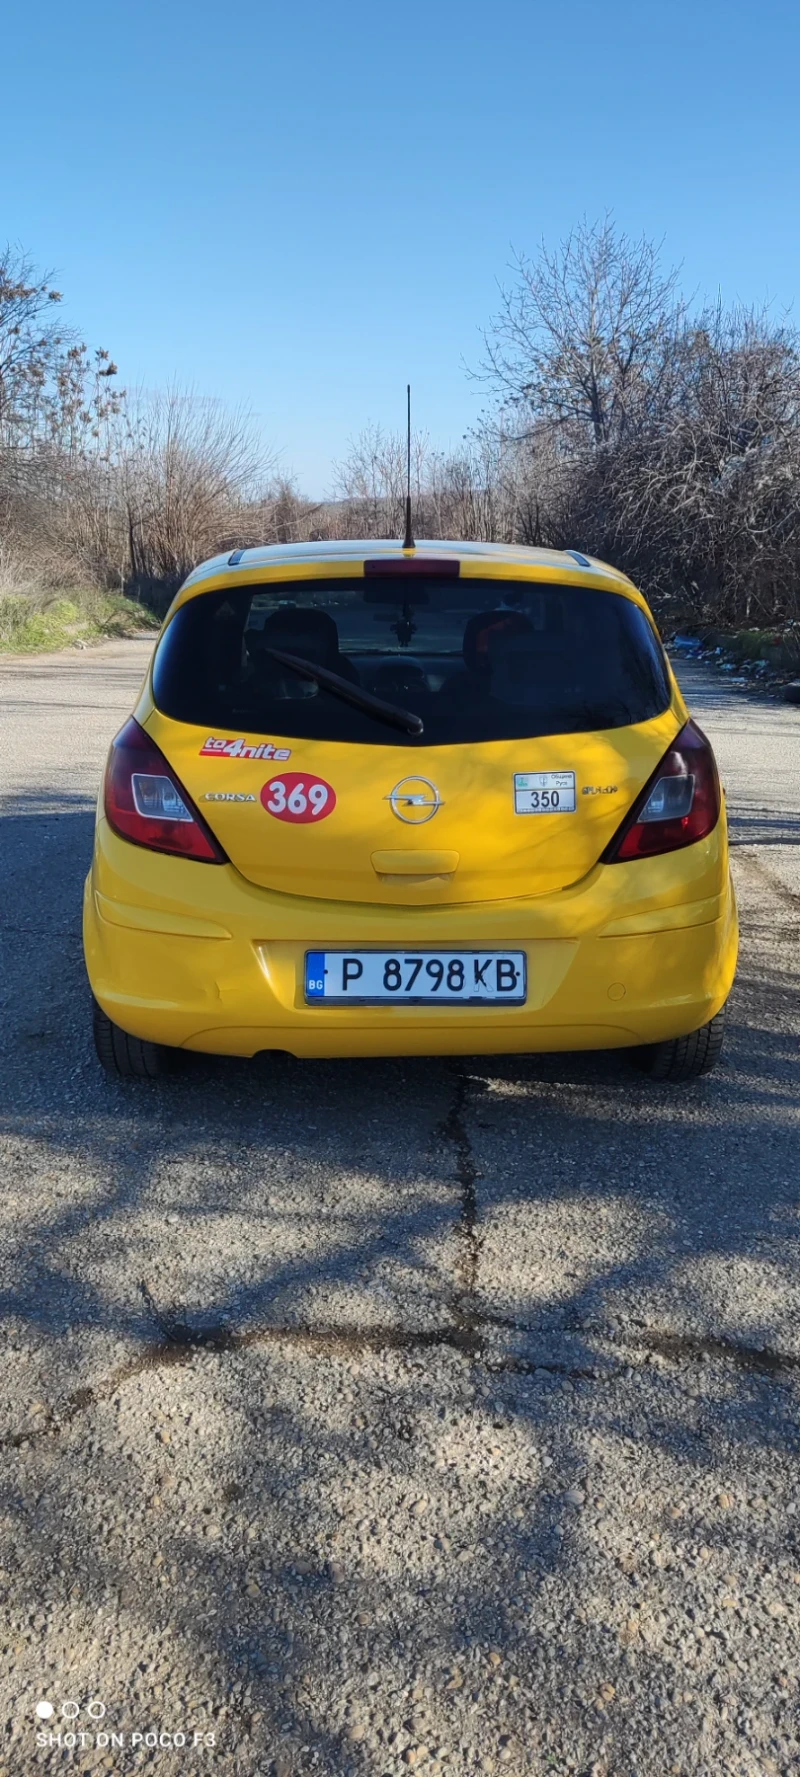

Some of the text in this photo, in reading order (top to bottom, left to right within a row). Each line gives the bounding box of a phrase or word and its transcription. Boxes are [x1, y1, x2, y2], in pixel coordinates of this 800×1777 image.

[203, 736, 291, 761] to4nite
[204, 792, 256, 802] CORSA
[267, 781, 328, 815] 369
[531, 791, 560, 808] 350
[309, 980, 323, 990] BG
[342, 958, 363, 991] P
[383, 958, 465, 992] 8798
